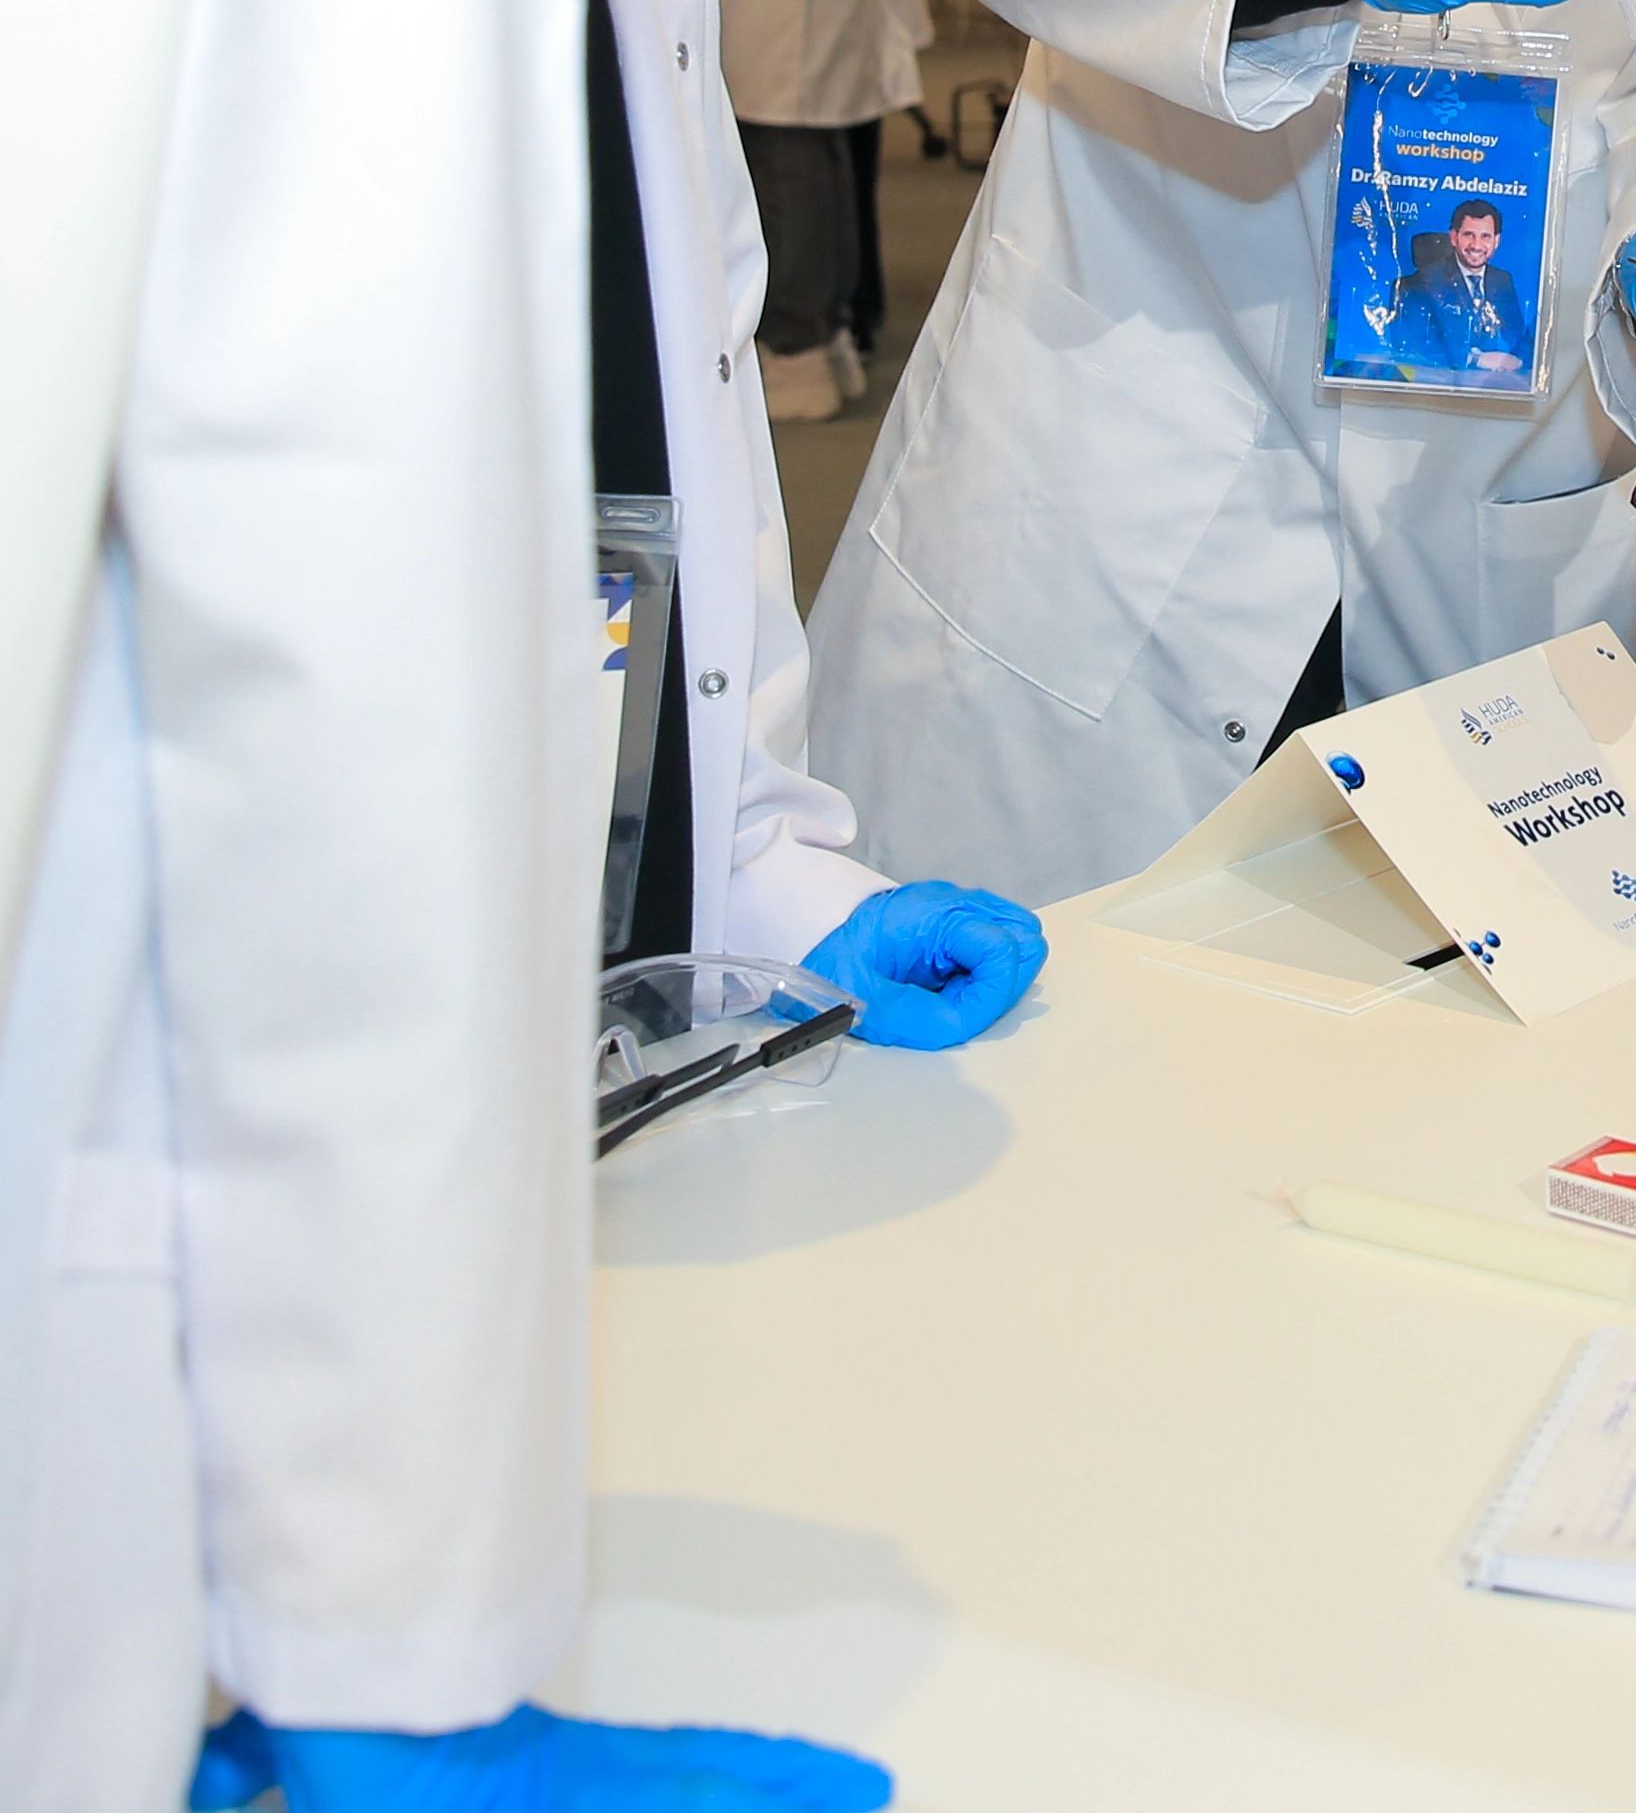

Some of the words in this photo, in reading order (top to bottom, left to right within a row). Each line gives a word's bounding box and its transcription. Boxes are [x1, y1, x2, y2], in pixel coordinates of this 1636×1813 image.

[1388, 125, 1499, 147] Nanotechnology
[1396, 143, 1485, 164] workshop
[1379, 171, 1439, 191] Ramzy
[1441, 175, 1528, 196] Abdelaziz
[1478, 695, 1520, 719] HUDA
[1487, 766, 1603, 818] Nanotechnology
[1503, 789, 1626, 847] Workshop
